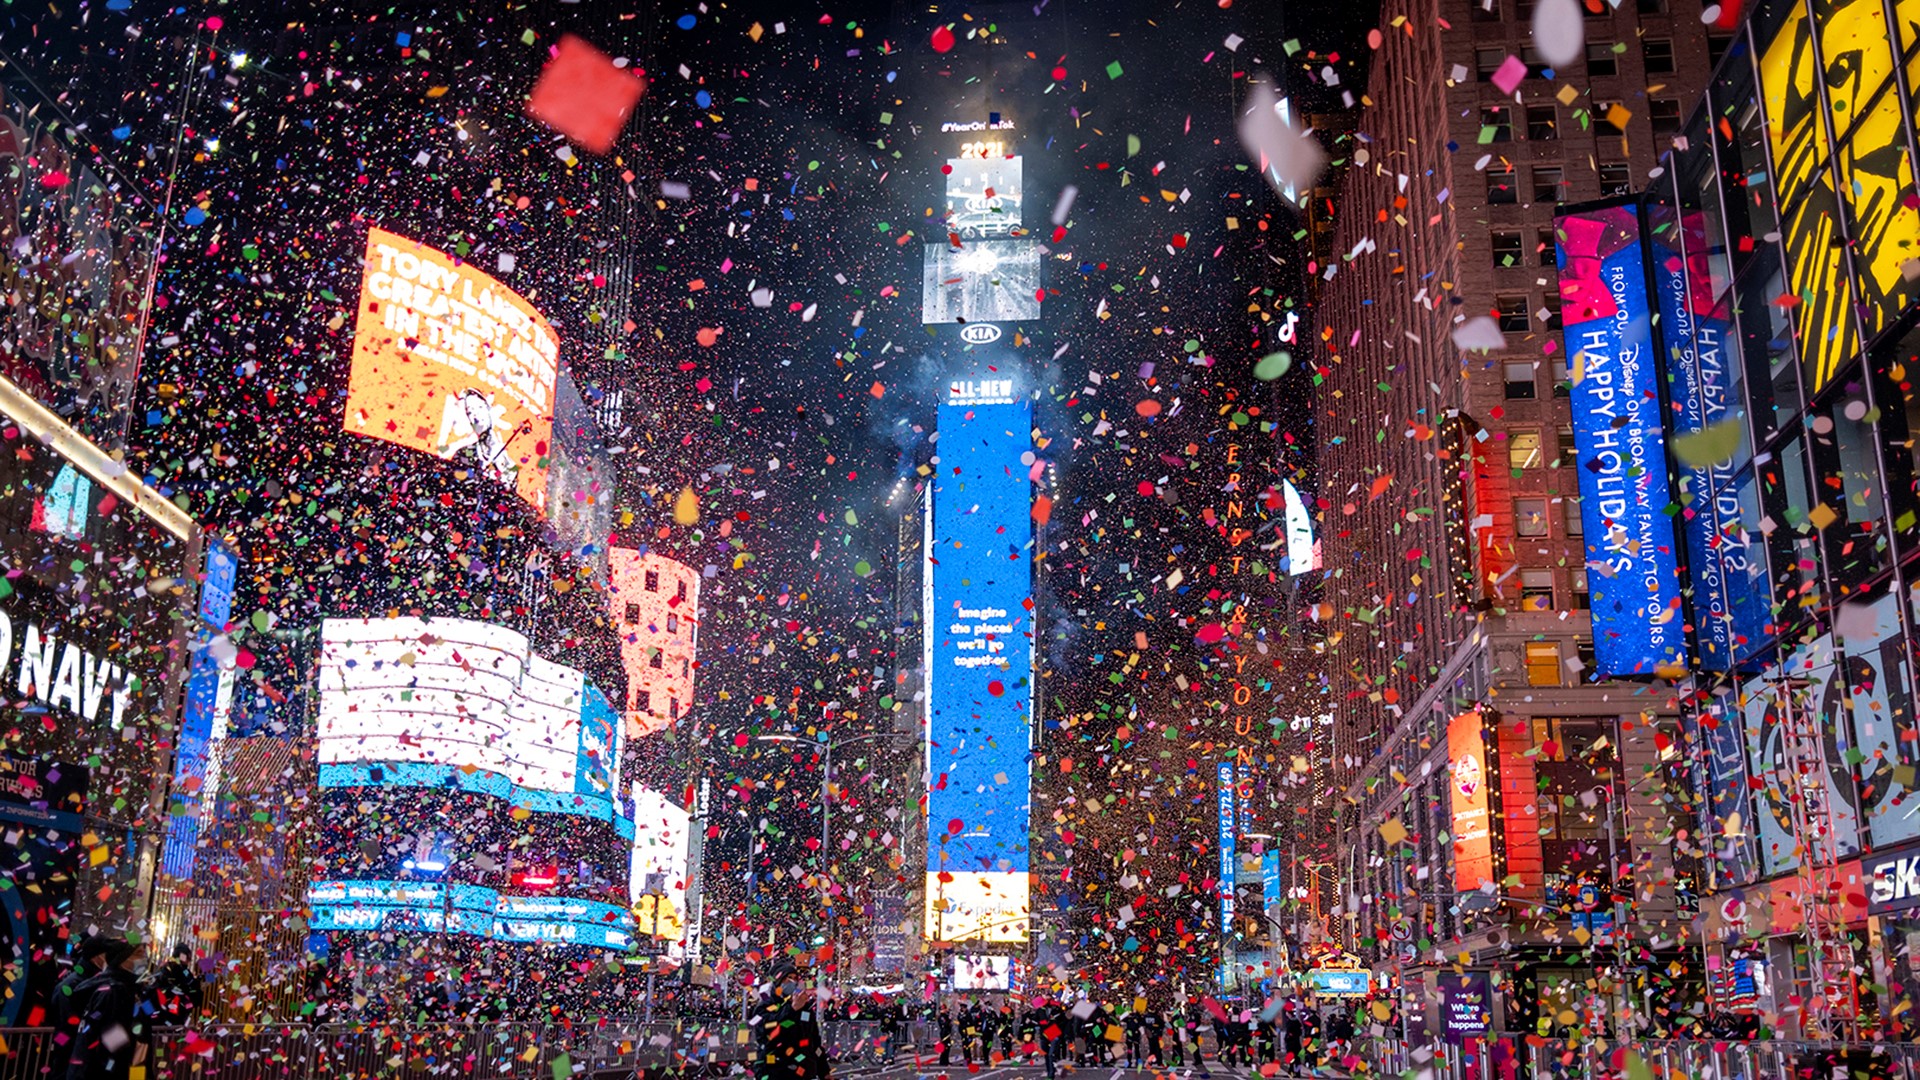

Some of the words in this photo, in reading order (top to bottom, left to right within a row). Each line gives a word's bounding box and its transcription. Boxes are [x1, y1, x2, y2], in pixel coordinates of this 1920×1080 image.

[961, 141, 1003, 158] 2021
[376, 243, 460, 295] TORY
[1610, 266, 1628, 305] FROM
[368, 272, 508, 347] GREATEST
[1614, 309, 1632, 339] OU
[383, 303, 420, 338] IN
[425, 318, 480, 363] THE
[966, 328, 996, 341] KIA
[949, 380, 1013, 398] ALL-NEW
[1581, 329, 1617, 418] HAPPY
[1625, 399, 1641, 424] ON
[1226, 444, 1244, 575] ERNST
[1592, 428, 1633, 575] HOLIDAYS
[1637, 513, 1656, 565] FAMILY
[1643, 567, 1659, 589] TO
[951, 623, 971, 634] the
[974, 623, 1013, 636] places
[1231, 604, 1249, 625] &
[17, 622, 138, 731] NAVY
[1233, 654, 1254, 799] YOUNG
[0, 756, 37, 777] TOR
[698, 776, 712, 815] Locker
[1451, 1003, 1480, 1012] Whre
[1448, 1020, 1485, 1031] happens
